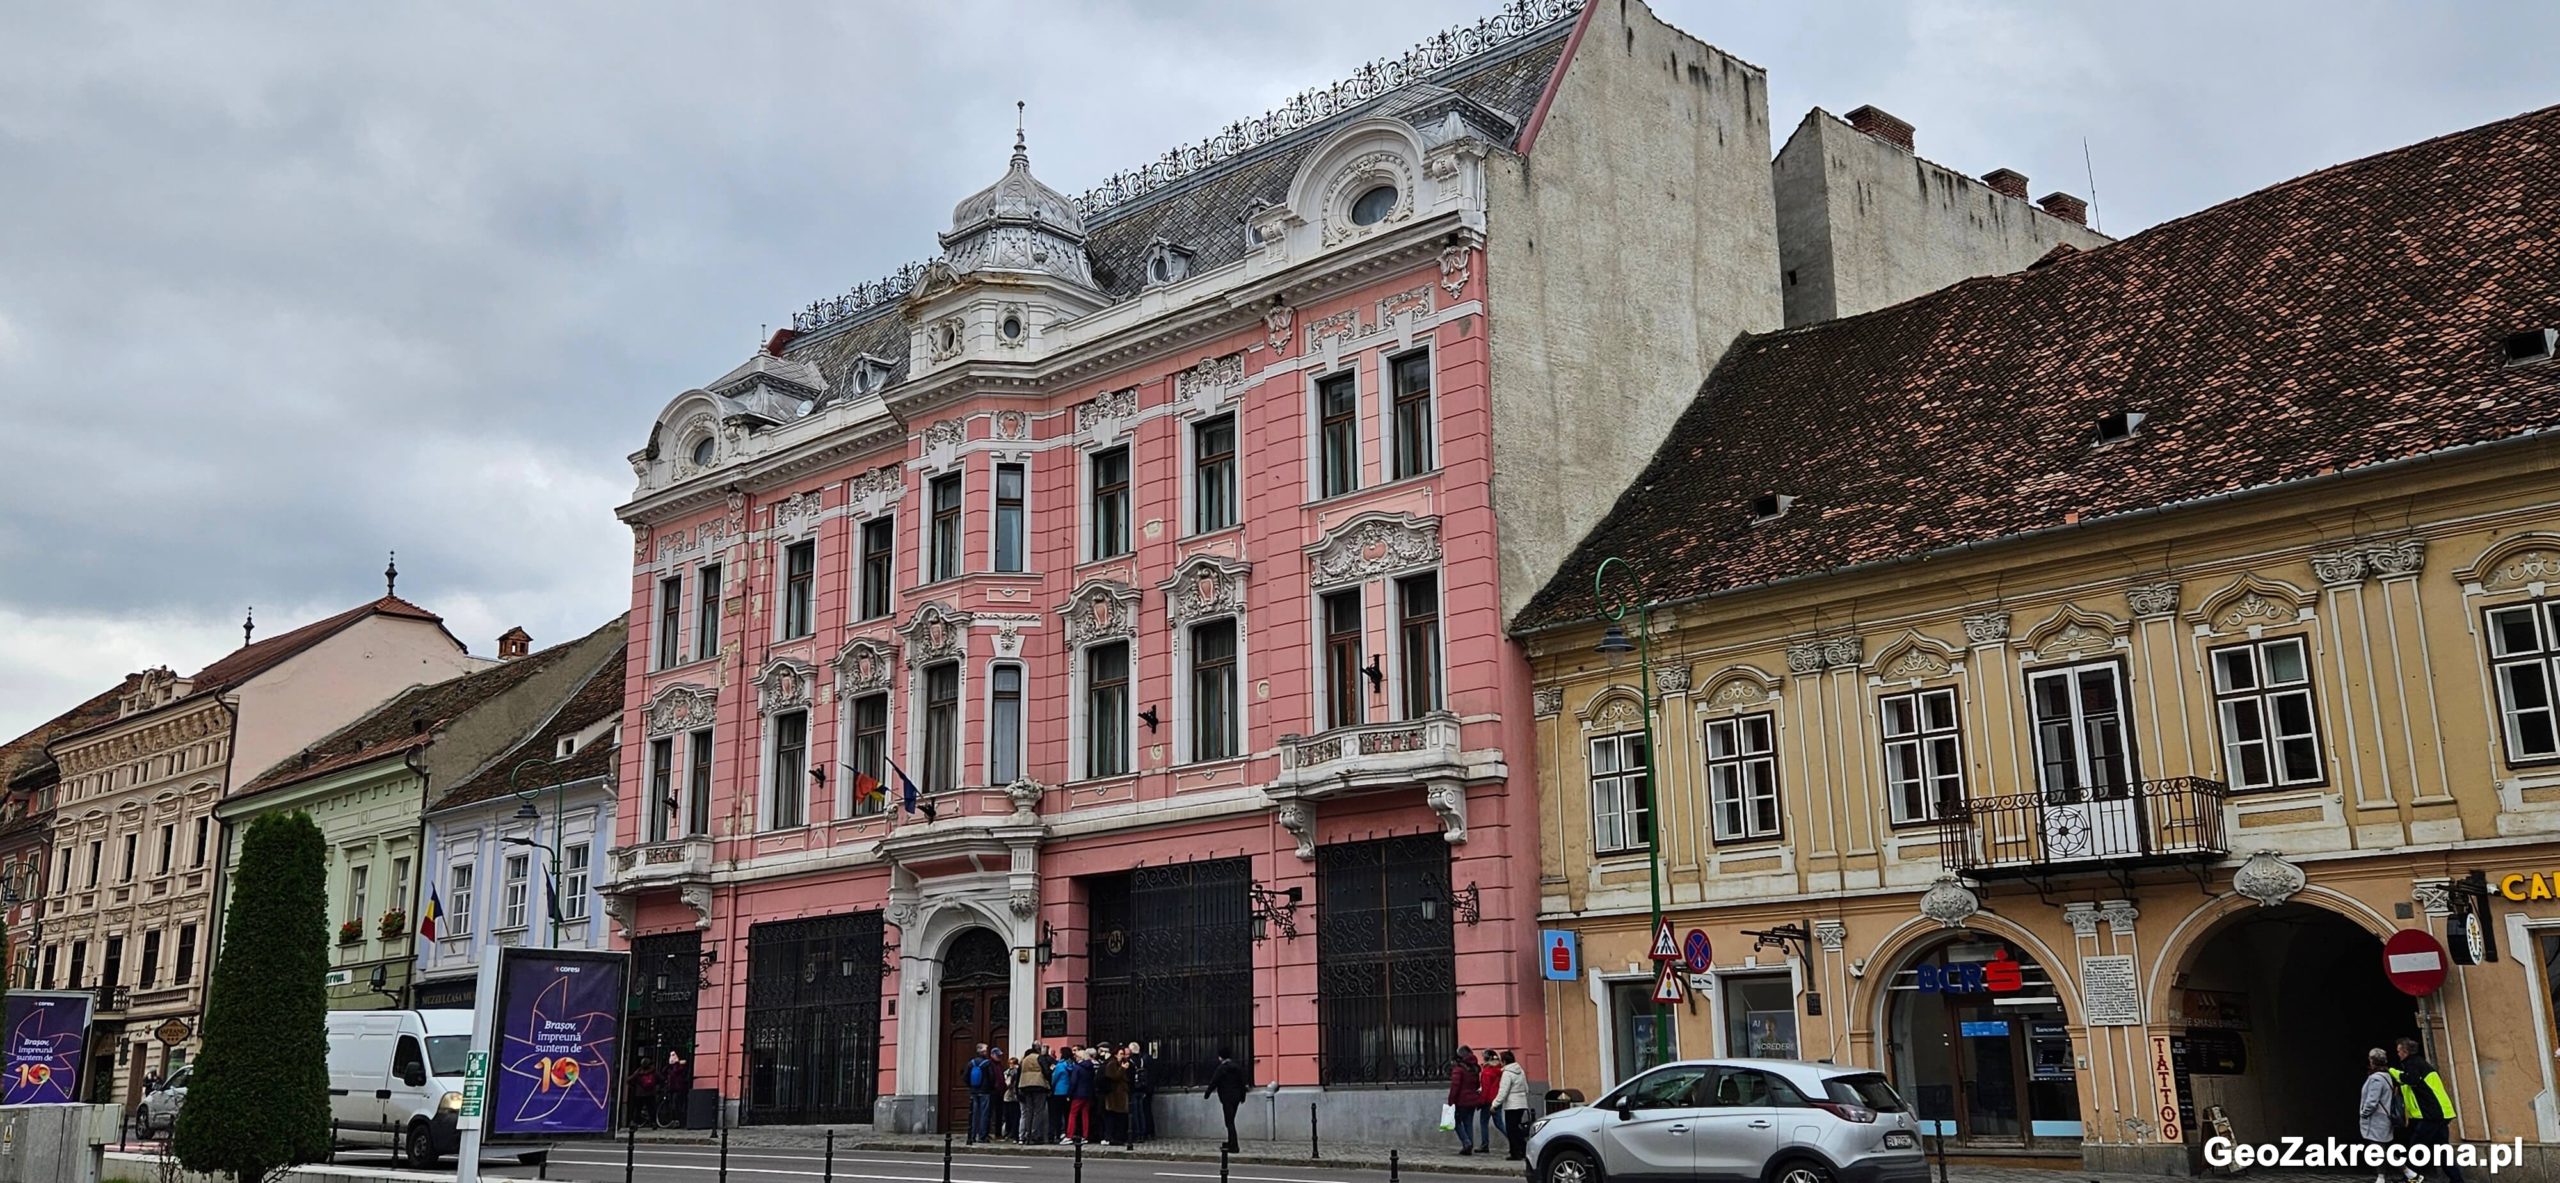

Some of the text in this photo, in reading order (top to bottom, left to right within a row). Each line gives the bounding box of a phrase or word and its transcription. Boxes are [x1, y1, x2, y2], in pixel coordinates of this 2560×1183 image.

[1917, 963, 1985, 994] BCR
[535, 1044, 582, 1053] suntem de
[537, 1031, 581, 1043] împreună
[15, 1063, 51, 1088] 10
[534, 1056, 580, 1094] 10
[2153, 1037, 2179, 1140] TATTOO
